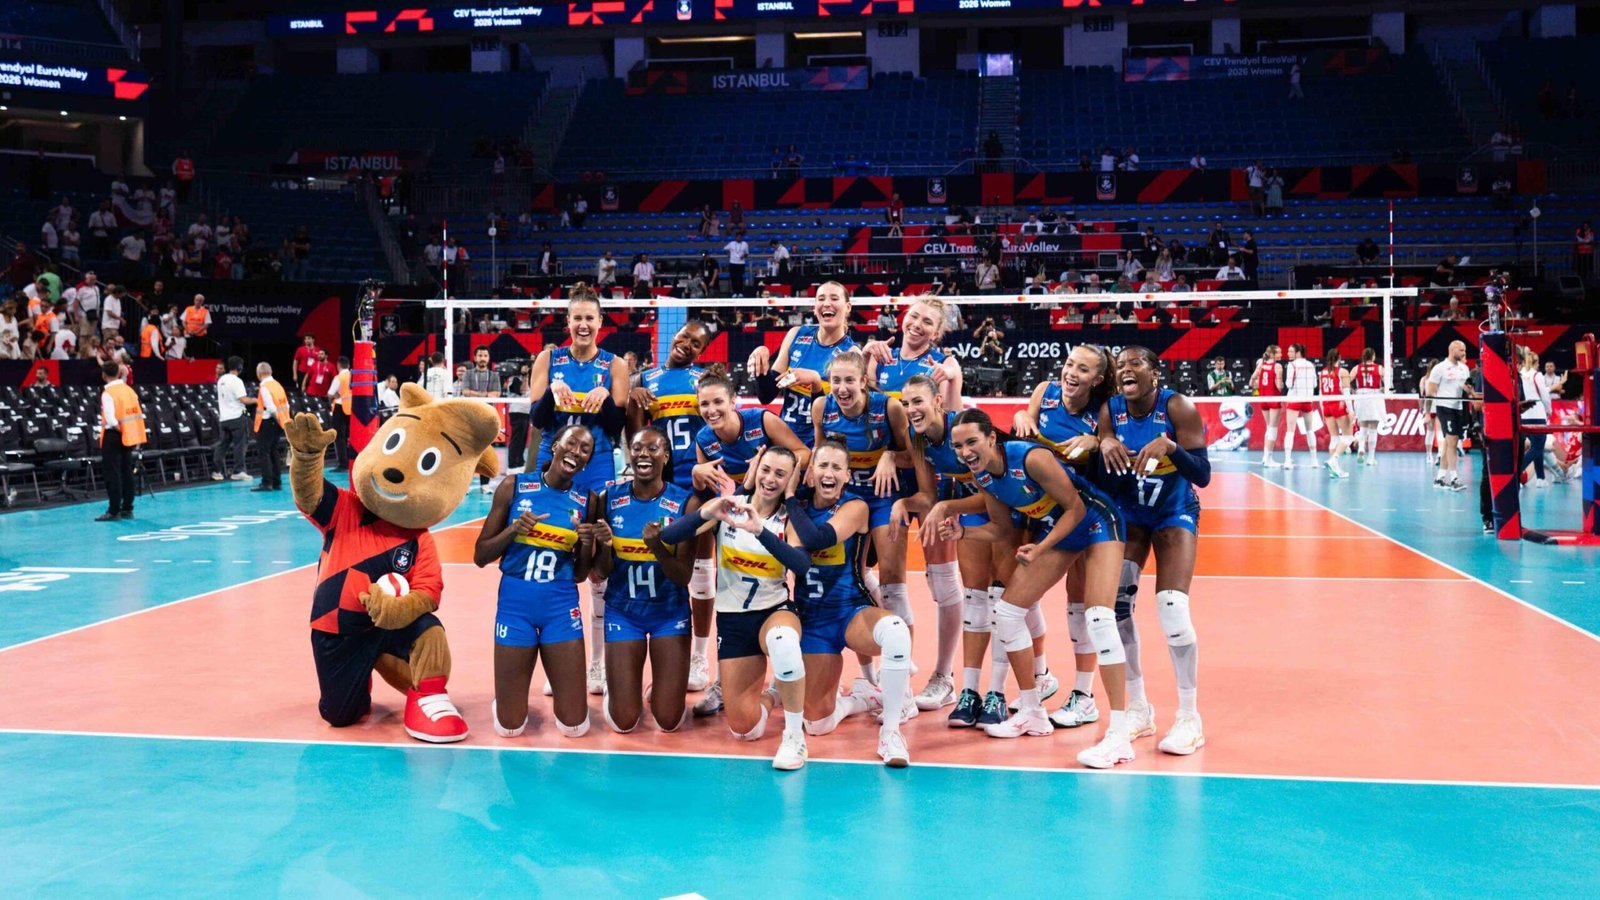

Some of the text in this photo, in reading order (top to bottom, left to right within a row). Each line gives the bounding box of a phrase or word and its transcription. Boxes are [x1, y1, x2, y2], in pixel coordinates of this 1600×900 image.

[757, 2, 794, 11] ISTANBUL
[290, 20, 324, 29] ISTANBUL
[474, 18, 522, 27] 2026 Women
[1203, 55, 1307, 67] CEV Trendyol EuroVolly
[0, 62, 88, 81] rendyol EuroVolley
[23, 77, 61, 89] Women
[712, 73, 790, 88] ISTANBUL
[325, 156, 402, 171] ISTANBUL
[923, 243, 947, 254] CEV
[222, 304, 258, 314] Trendyol
[260, 305, 302, 315] EuroVolley
[226, 315, 280, 325] 2026 Women
[1017, 342, 1060, 358] 2026
[659, 401, 692, 410] DHL
[665, 418, 691, 450] 15
[1137, 478, 1163, 507] 17
[527, 529, 566, 544] DHL
[622, 545, 654, 553] DH
[524, 550, 557, 583] 18
[732, 556, 768, 571] DHL
[628, 565, 656, 599] 14
[805, 567, 825, 599] 5
[741, 576, 760, 609] 7
